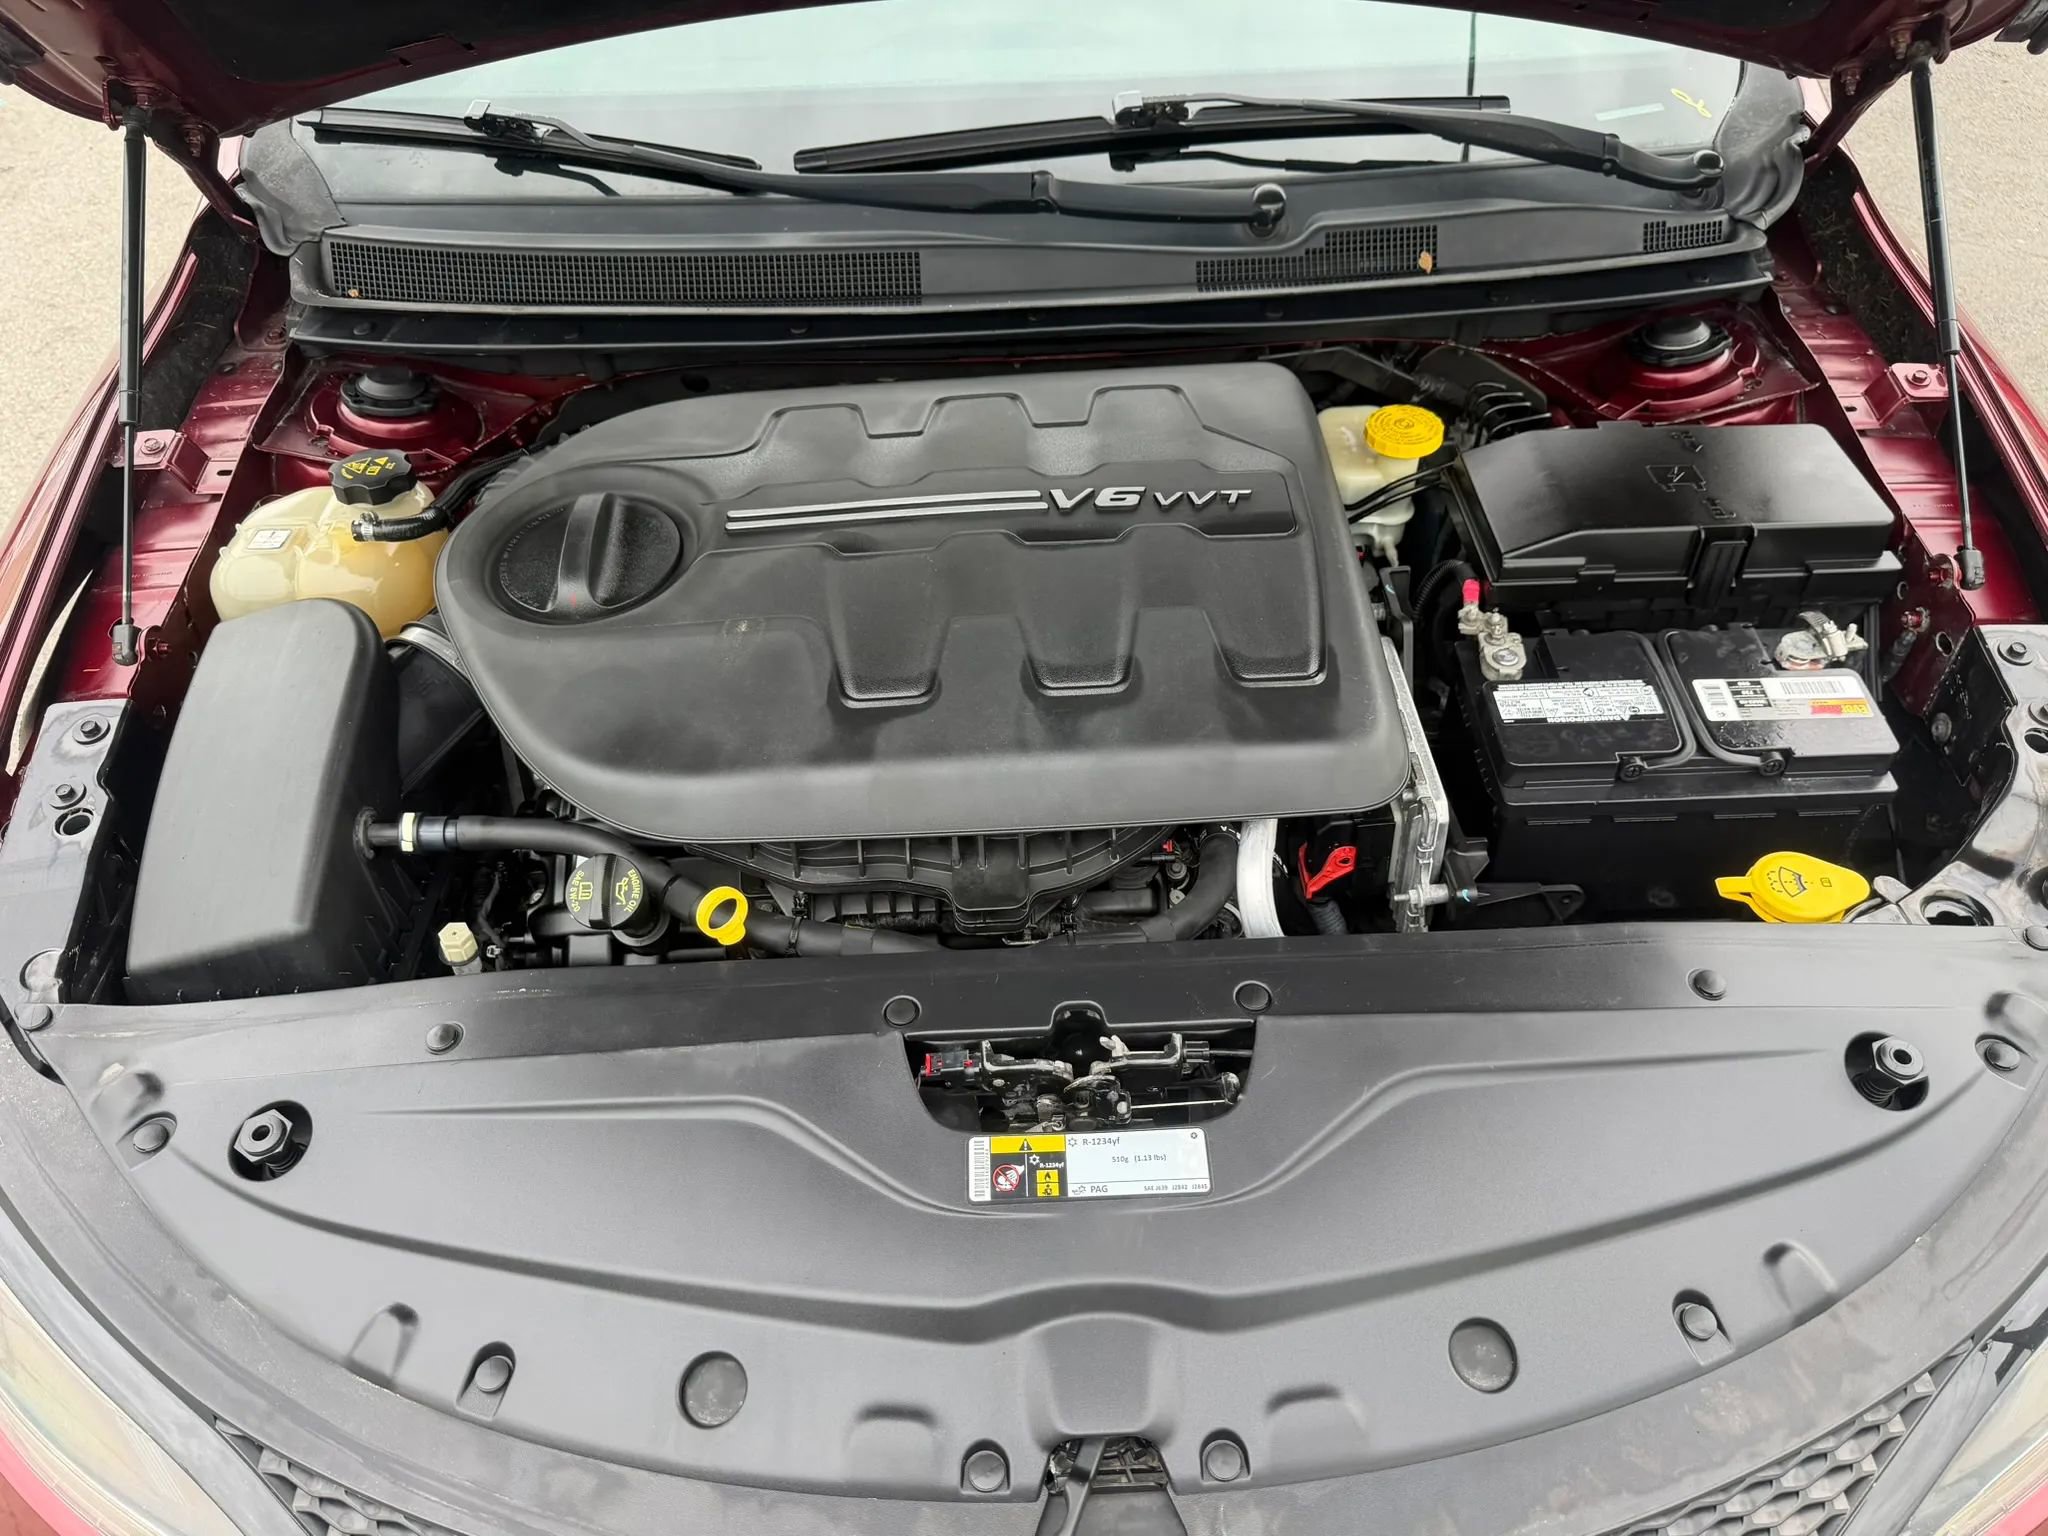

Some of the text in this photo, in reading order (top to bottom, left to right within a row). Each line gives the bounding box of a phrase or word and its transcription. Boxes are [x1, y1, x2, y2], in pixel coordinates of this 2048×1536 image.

[1050, 486, 1253, 509] V6 VVT
[571, 870, 585, 886] SAE
[623, 868, 641, 913] ENGINE OIL
[1082, 1137, 1120, 1147] R-1234yf
[1134, 1154, 1152, 1162] (1.13
[1153, 1153, 1167, 1161] lbs)
[1090, 1185, 1108, 1193] PAG
